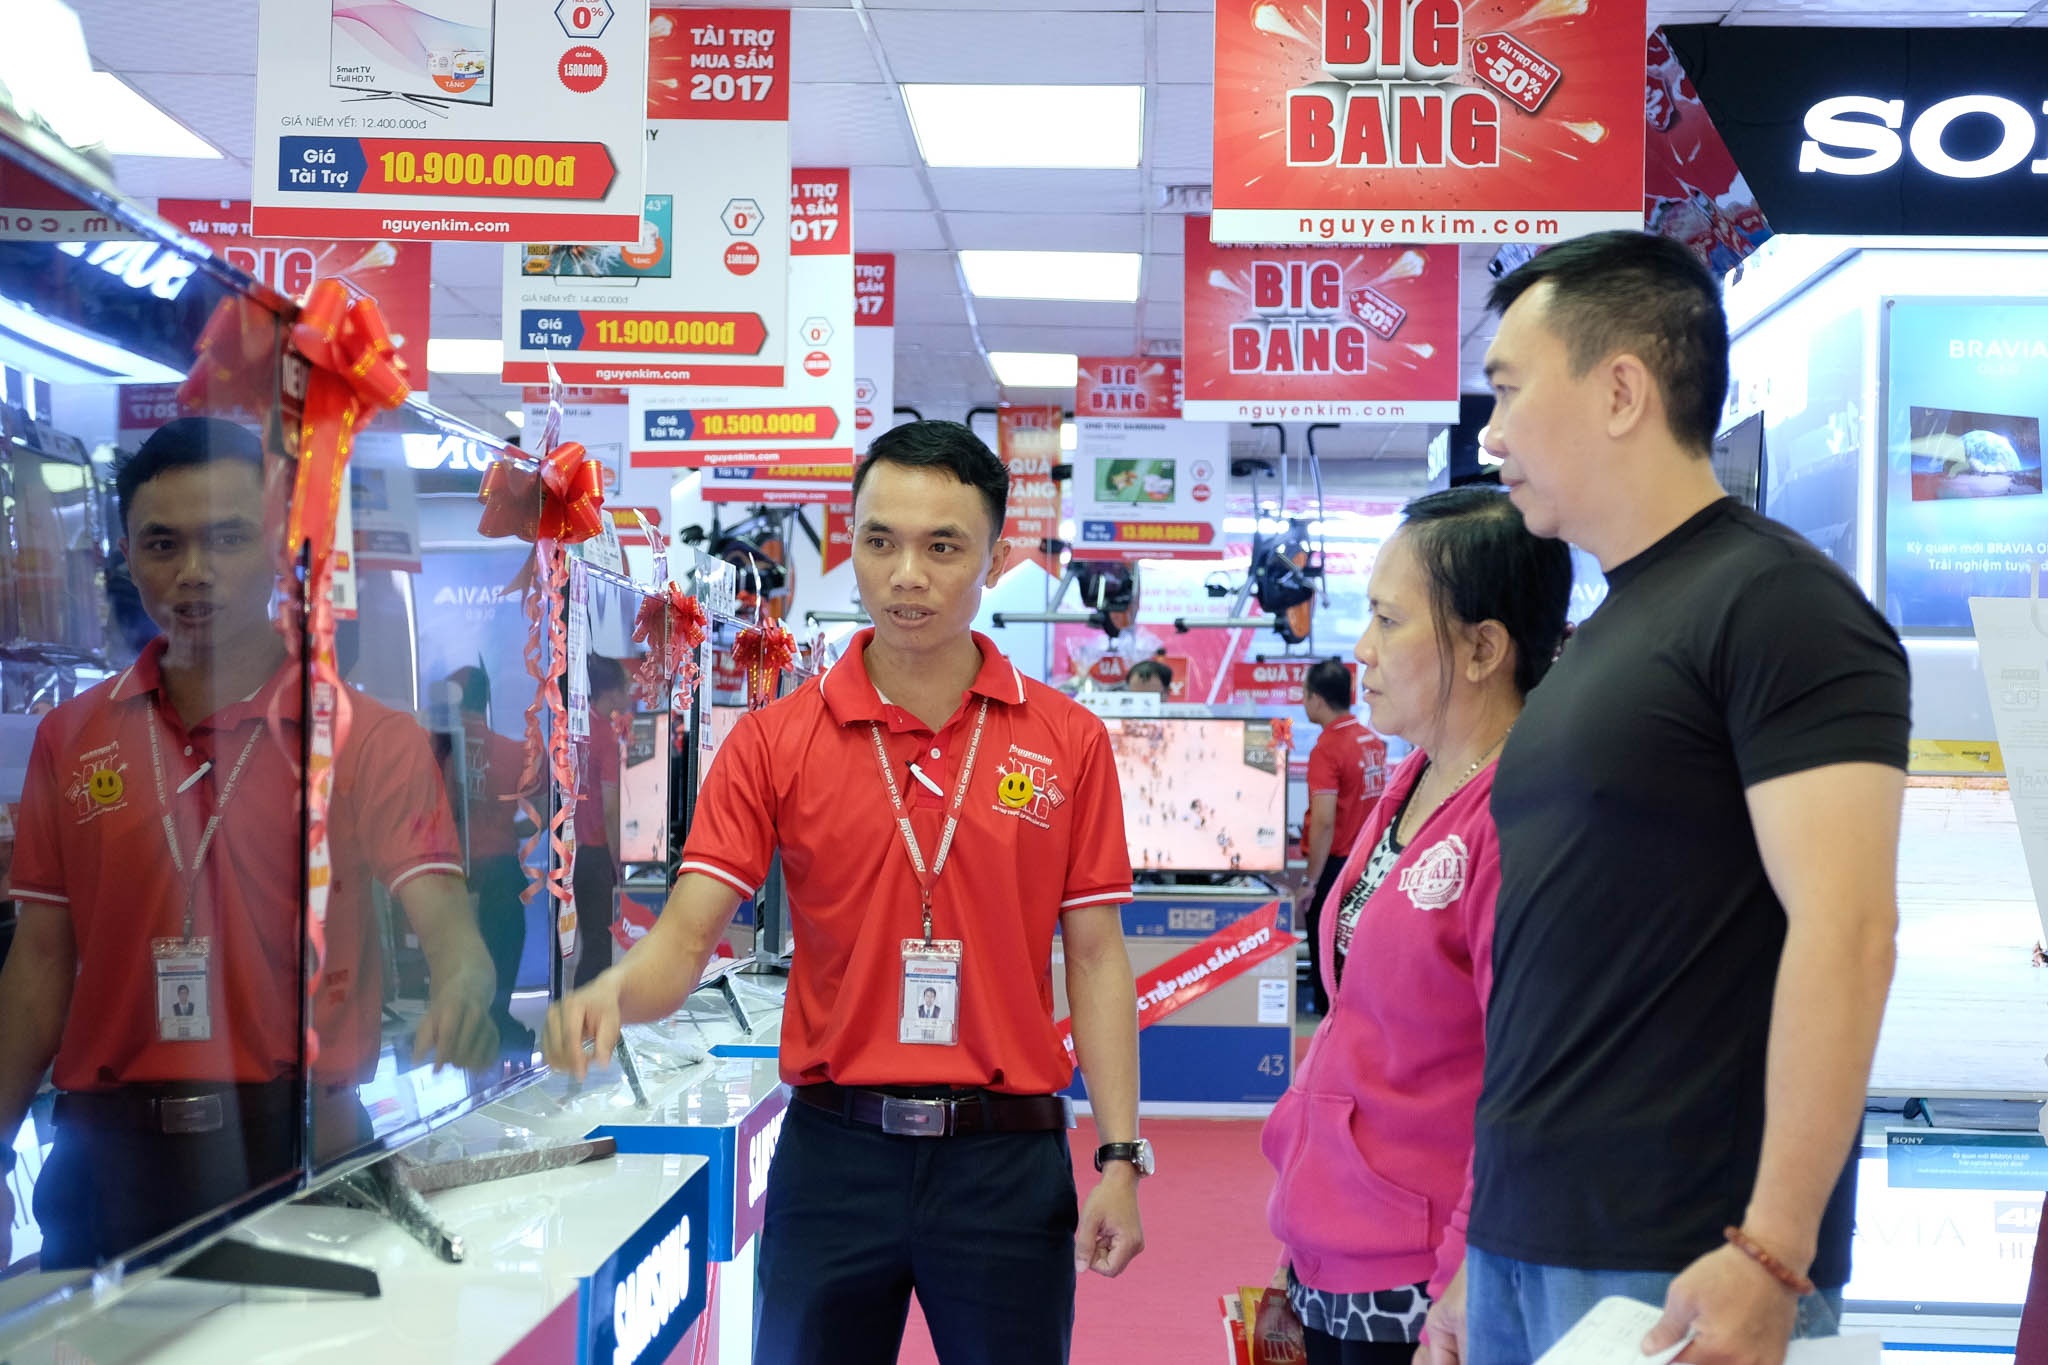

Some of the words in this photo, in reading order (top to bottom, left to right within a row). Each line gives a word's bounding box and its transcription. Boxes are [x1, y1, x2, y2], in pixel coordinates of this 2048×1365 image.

[573, 6, 604, 29] 0%
[690, 24, 725, 46] TÀI
[730, 28, 775, 51] TRỢ
[1321, 0, 1463, 80] BIG
[690, 54, 730, 69] MUA
[734, 49, 774, 70] SẮM
[1497, 39, 1513, 55] TÀI
[1512, 49, 1532, 68] TRỢ
[336, 66, 359, 74] Smart
[336, 75, 350, 83] Full
[690, 75, 774, 101] 2017
[281, 115, 302, 127] GIÁ
[361, 118, 427, 130] 12.400.000đ
[1286, 86, 1501, 168] BANG
[1799, 94, 2048, 178] SO
[303, 148, 336, 164] Giá
[290, 167, 316, 183] Tài
[321, 169, 349, 188] Trợ
[380, 151, 576, 187] 10.900.000đ
[806, 199, 839, 216] SẮM
[188, 220, 209, 233] TÀI
[212, 222, 238, 237] TRỢ
[382, 217, 510, 234] nguyenkim.com
[791, 219, 839, 242] 017
[1299, 214, 1560, 238] nguyenkim.com
[1251, 260, 1344, 317] BIG
[538, 318, 562, 330] Giá
[595, 320, 736, 345] 11.900.000đ
[528, 332, 548, 344] Tài
[551, 333, 572, 348] Trợ
[1229, 321, 1368, 375] BANG
[1949, 339, 2048, 359] BRAVIA
[595, 367, 690, 382] nguyenkim.com
[1101, 366, 1138, 386] BIG
[1092, 391, 1147, 411] BANG
[1239, 404, 1405, 418] nguyenkim.com
[657, 415, 678, 427] Giá
[702, 413, 816, 436] 10.500.000đ
[649, 427, 667, 438] Tài
[668, 427, 686, 439] Trợ
[704, 452, 780, 465] nguyenkim.com
[1925, 543, 1956, 557] quan
[1959, 541, 1984, 553] mới
[1987, 542, 2033, 553] BRAVIA
[1955, 558, 2002, 573] nghiệm
[1253, 664, 1288, 682] QUÀ
[1150, 979, 1178, 1005] TIẾP
[1178, 963, 1211, 989] MUA
[1207, 946, 1240, 972] SẮM
[1237, 926, 1271, 955] 2017
[1257, 1053, 1284, 1077] 43
[1892, 1136, 1924, 1145] SONY
